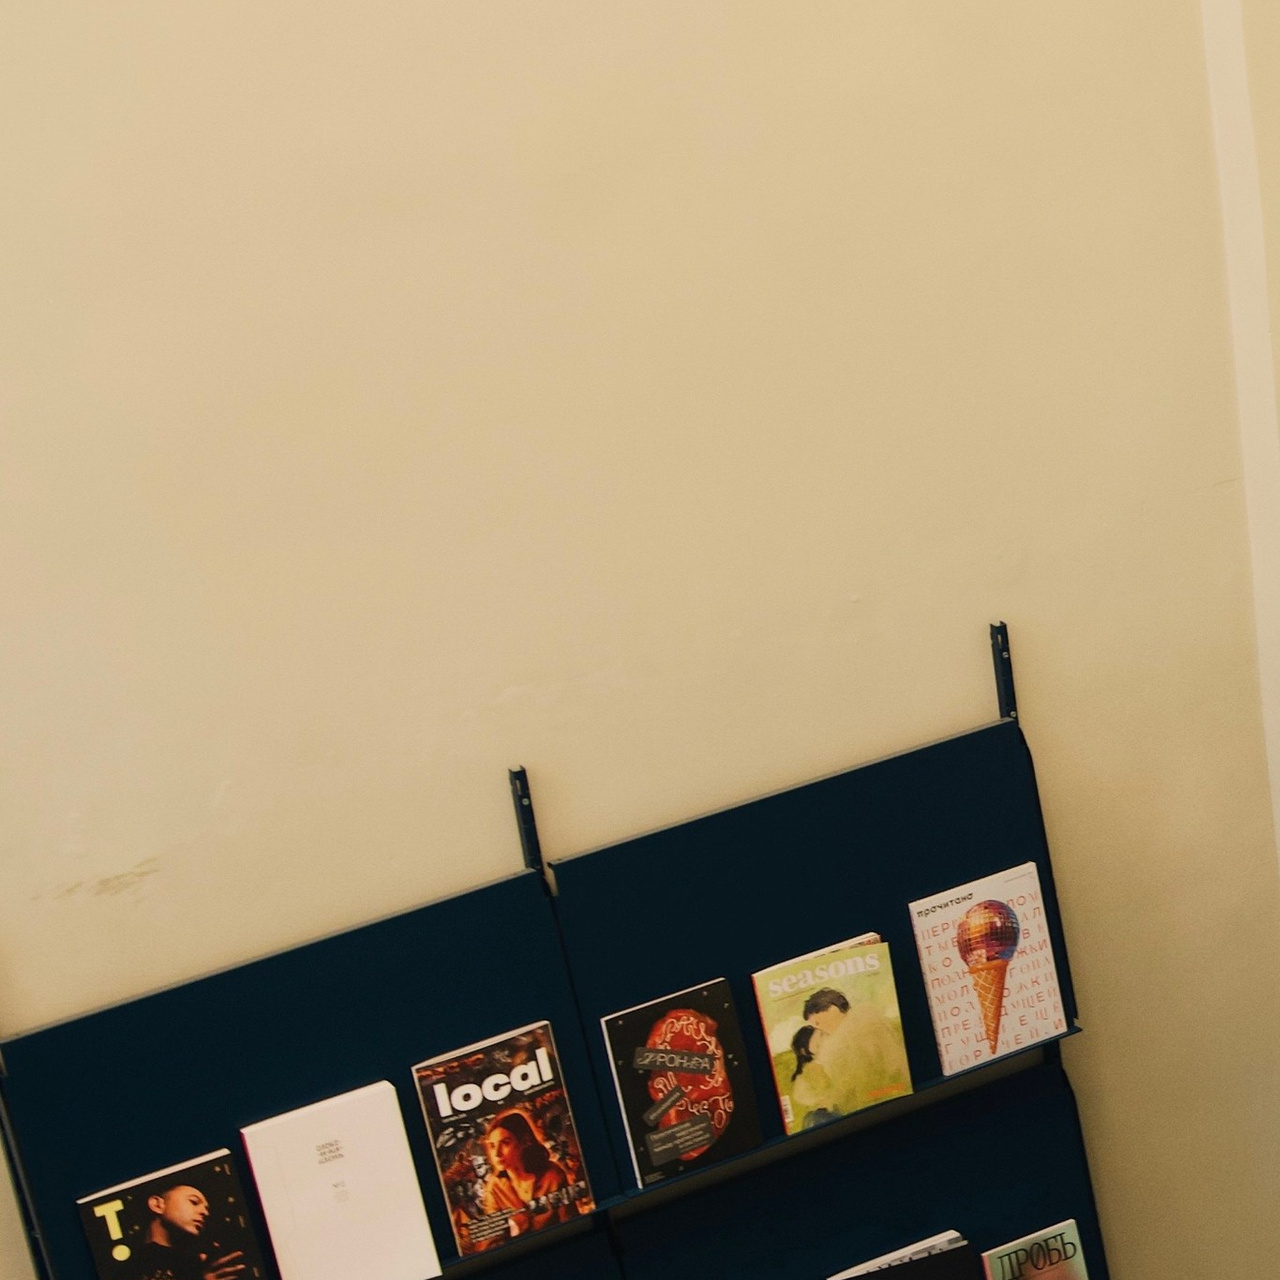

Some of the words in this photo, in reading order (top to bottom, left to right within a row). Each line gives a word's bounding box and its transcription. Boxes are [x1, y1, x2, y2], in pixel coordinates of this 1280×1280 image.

[916, 892, 974, 918] прочитано
[768, 952, 881, 997] seasons
[433, 1047, 554, 1118] local
